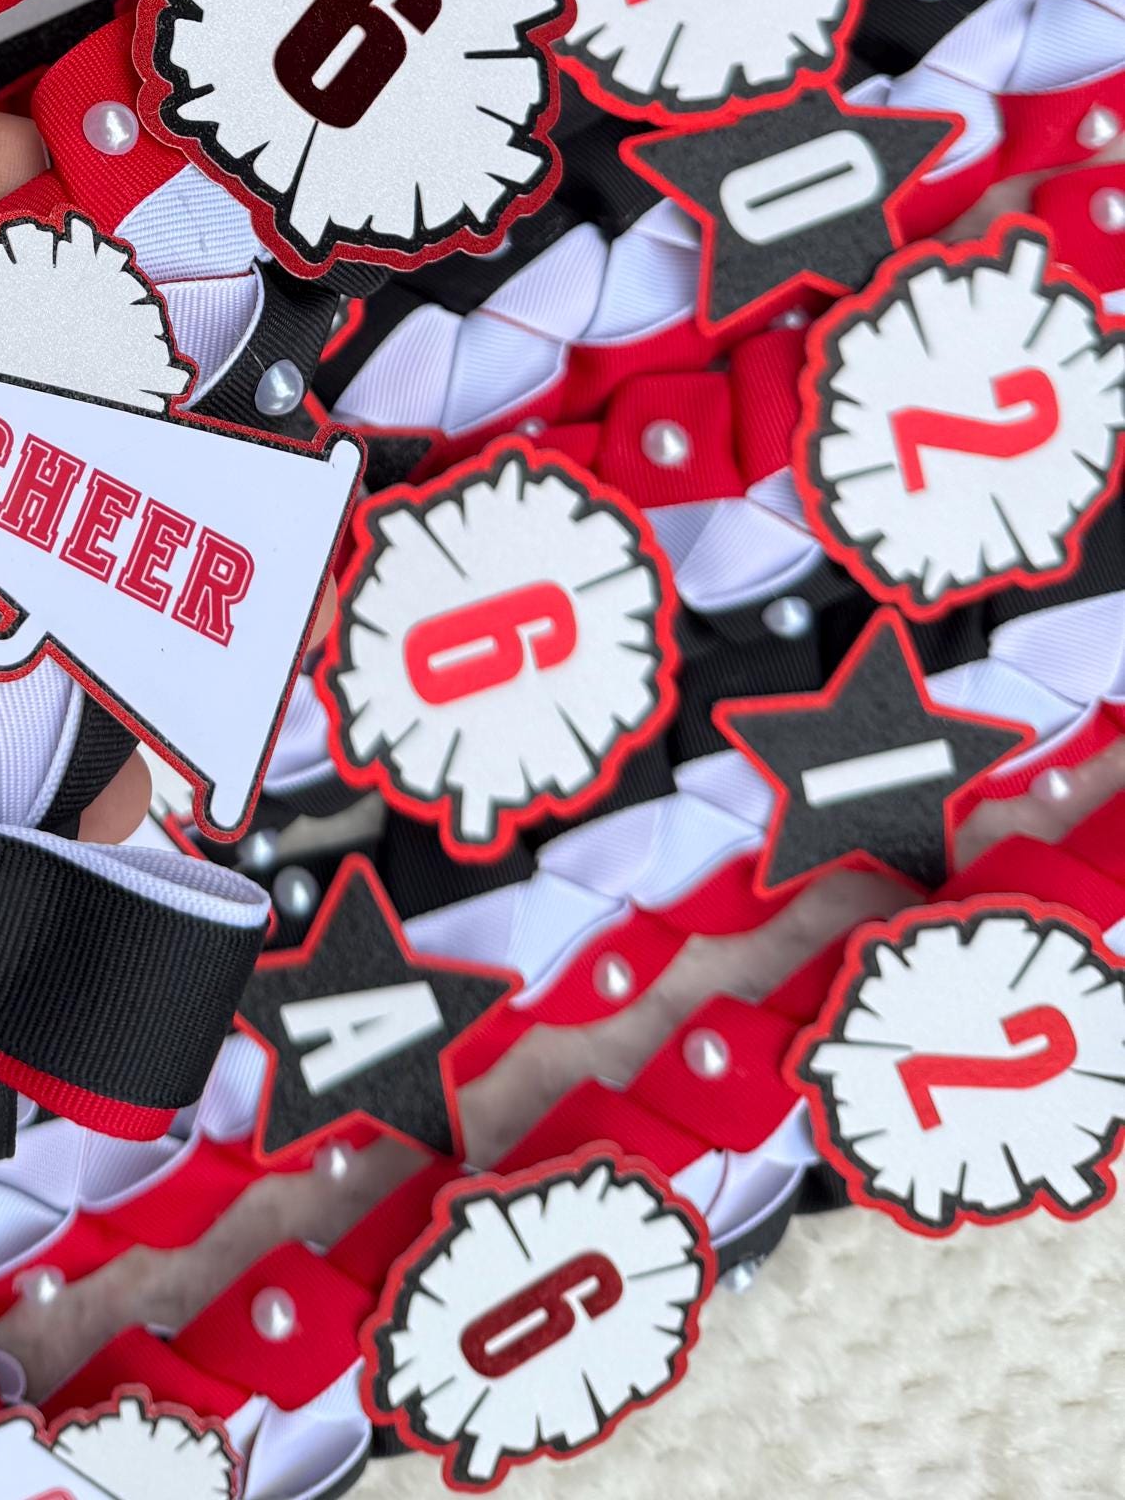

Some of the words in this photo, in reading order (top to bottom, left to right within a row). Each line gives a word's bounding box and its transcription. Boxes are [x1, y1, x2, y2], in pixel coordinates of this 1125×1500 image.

[888, 367, 1060, 495] 2
[403, 580, 578, 706] 6
[279, 980, 444, 1096] A
[895, 1004, 1077, 1132] 2
[459, 1251, 623, 1378] 6
